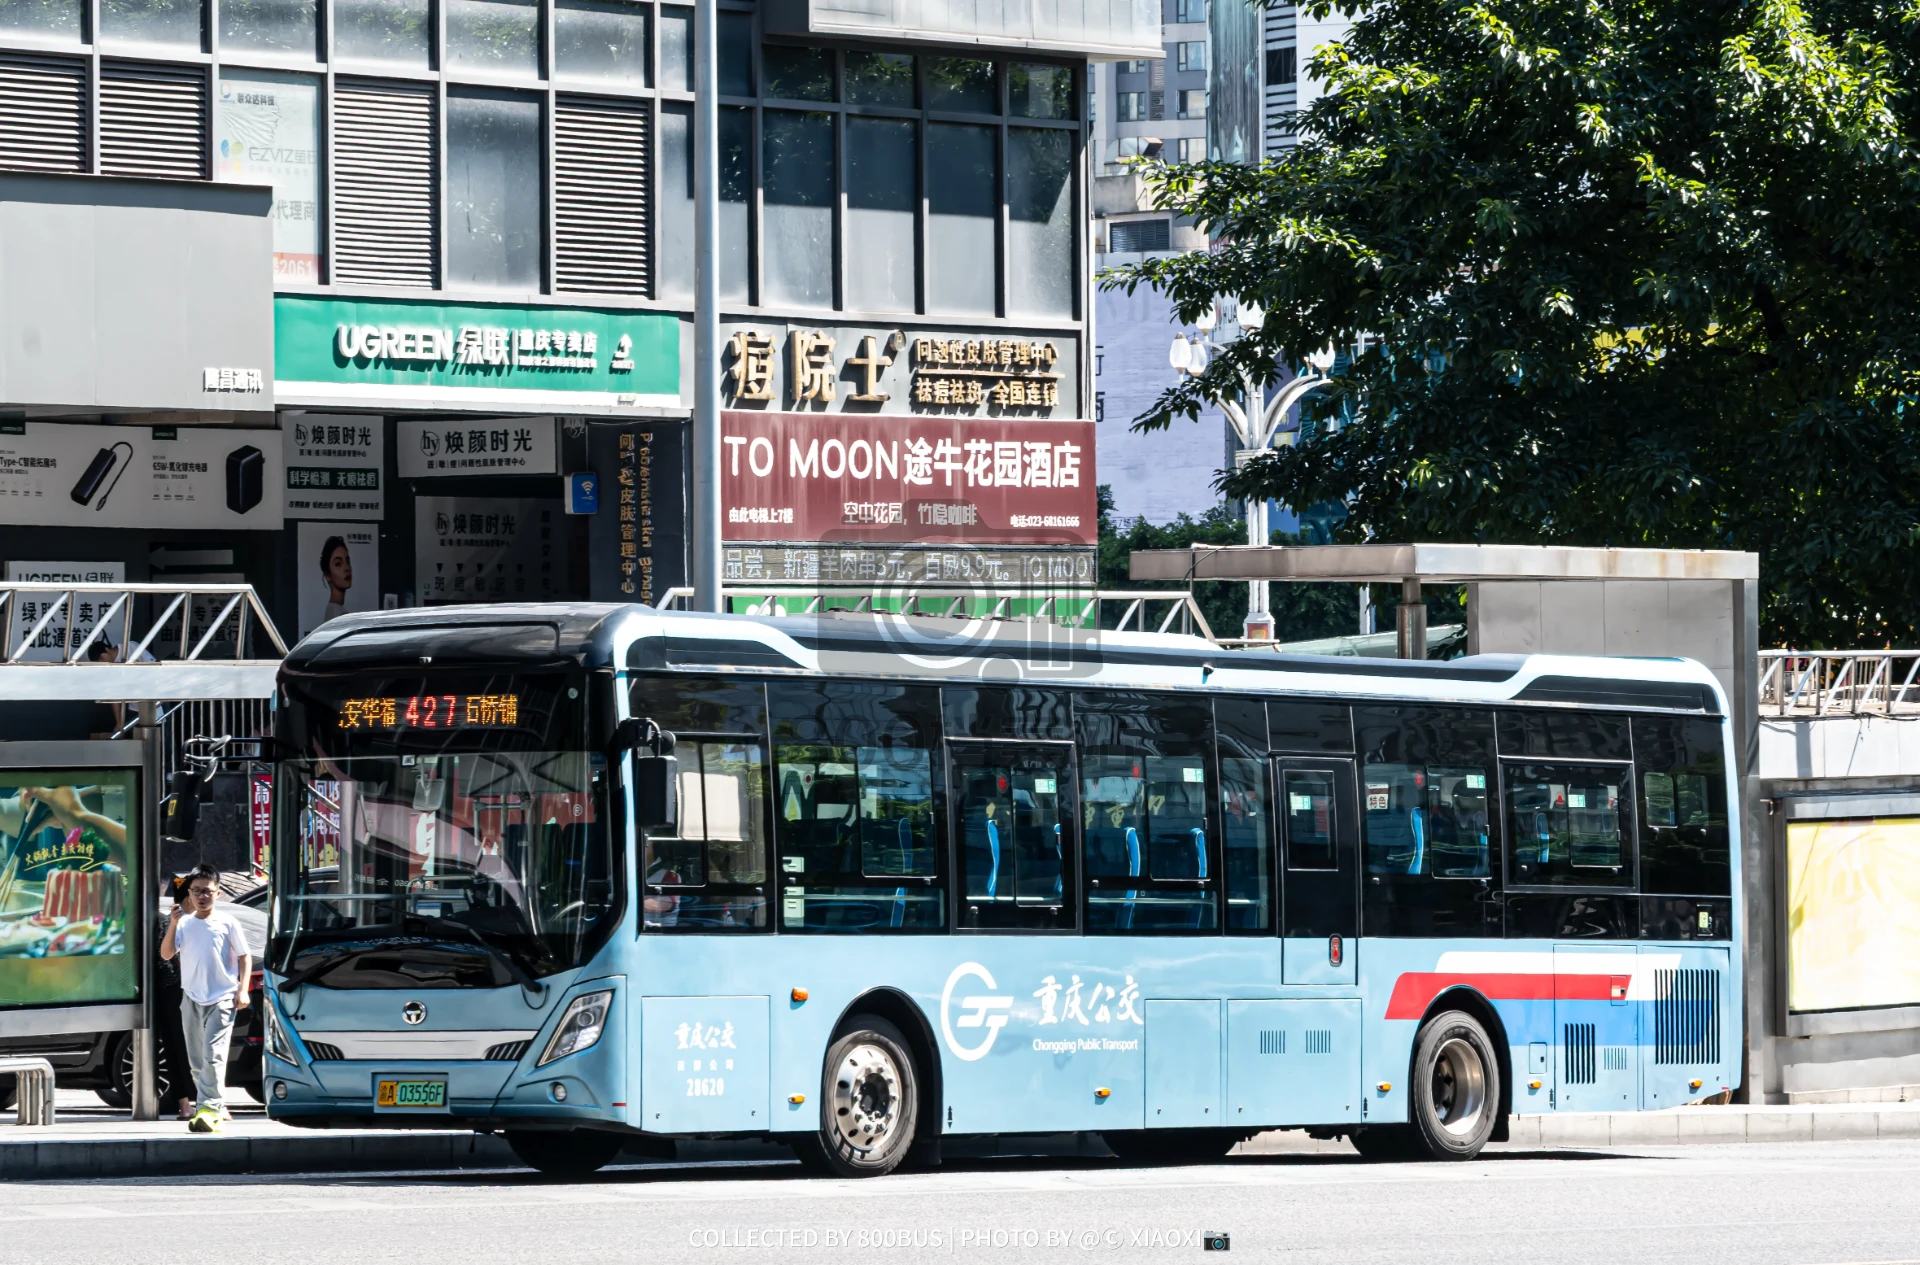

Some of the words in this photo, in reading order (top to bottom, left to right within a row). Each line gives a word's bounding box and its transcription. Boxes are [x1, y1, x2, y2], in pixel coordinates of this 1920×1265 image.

[272, 200, 317, 220] 代理商
[337, 325, 453, 360] UGREEN
[455, 326, 510, 366] 绿联
[519, 328, 597, 353] 重庆专卖店
[917, 338, 1060, 366] 问题性皮肤管理中心
[730, 330, 892, 401] 痘院士
[916, 377, 983, 406] 祛痘祛斑
[992, 379, 1060, 409] 全国连锁
[311, 425, 371, 446] 焕颜时光
[445, 429, 532, 453] 焕颜时光
[724, 435, 774, 478] TO
[789, 438, 898, 480] MOON
[903, 436, 1081, 488] 途牛花园酒店
[290, 471, 330, 485] 科学检测
[453, 513, 516, 535] 焕颜时光
[728, 507, 794, 524] 由此电梯上7楼
[918, 503, 977, 525] 竹隐咖啡
[406, 695, 457, 727] 427
[466, 694, 518, 724] 石桥铺
[1032, 974, 1144, 1026] 重庆公交
[674, 1021, 737, 1050] 重庆公交
[1032, 1037, 1077, 1053] Chongqing
[1077, 1038, 1101, 1051] Public
[1102, 1039, 1138, 1052] Transport
[686, 1078, 725, 1097] 28620
